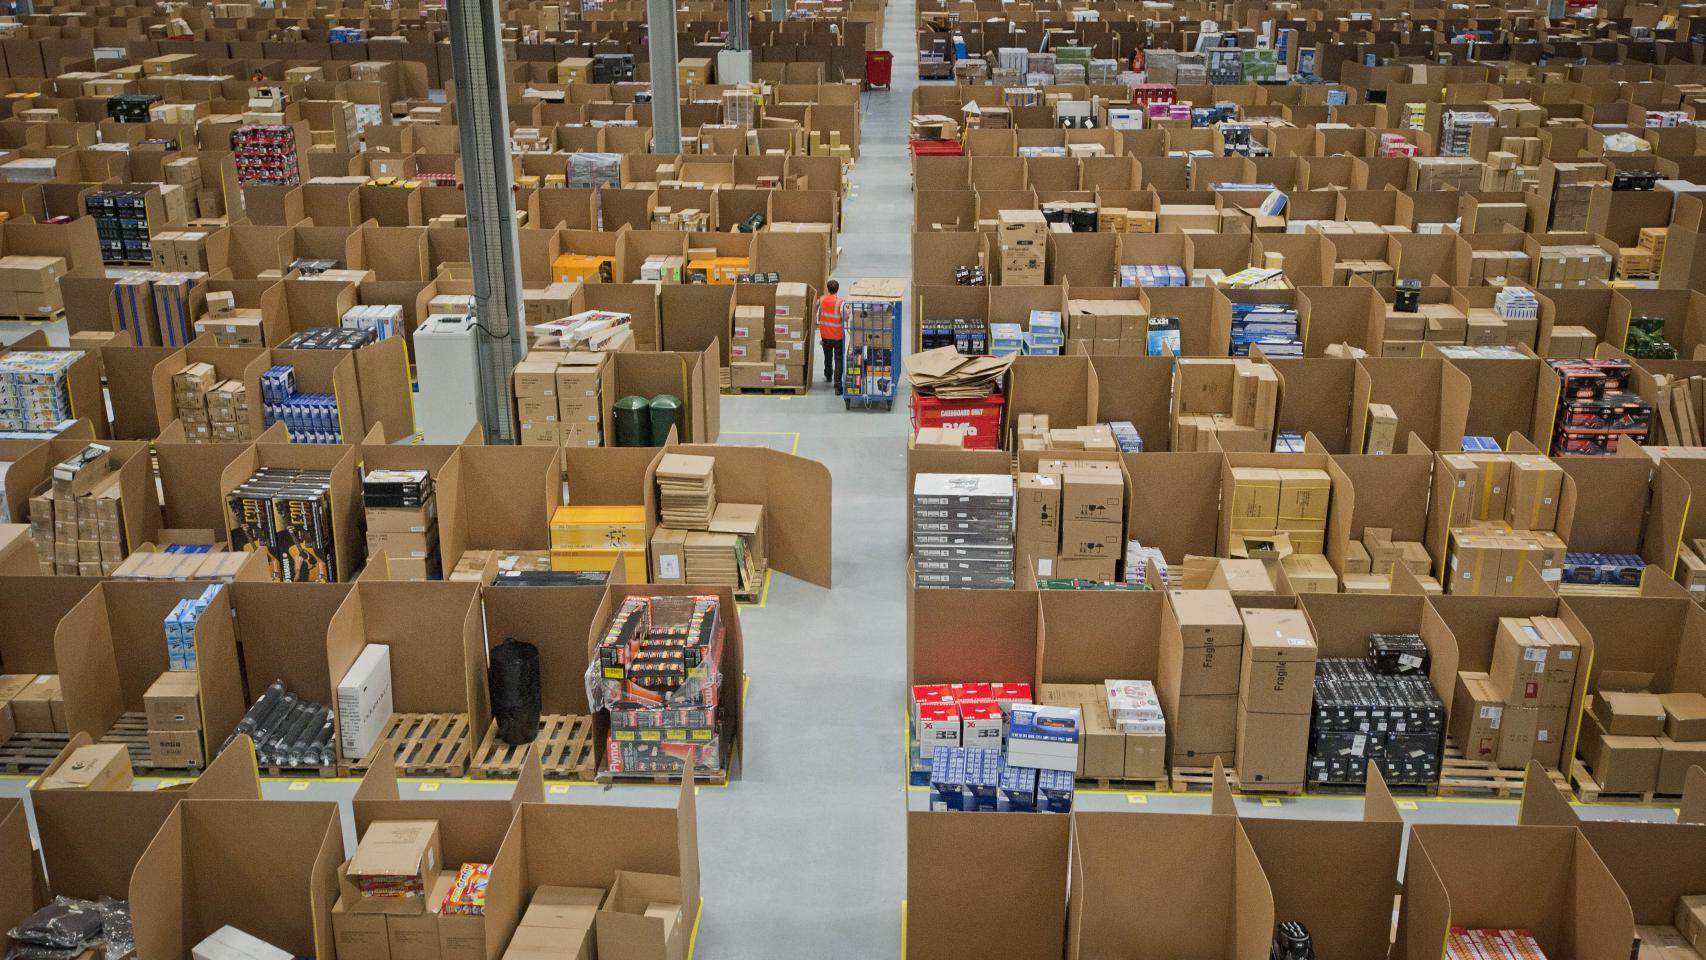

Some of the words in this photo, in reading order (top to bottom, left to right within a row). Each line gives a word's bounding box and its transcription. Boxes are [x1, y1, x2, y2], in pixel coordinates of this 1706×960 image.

[941, 409, 970, 417] CARDBOARD
[971, 408, 984, 416] ONLY
[1203, 637, 1216, 668] Fragile
[1274, 661, 1287, 691] Fragile
[609, 742, 621, 772] Flymo
